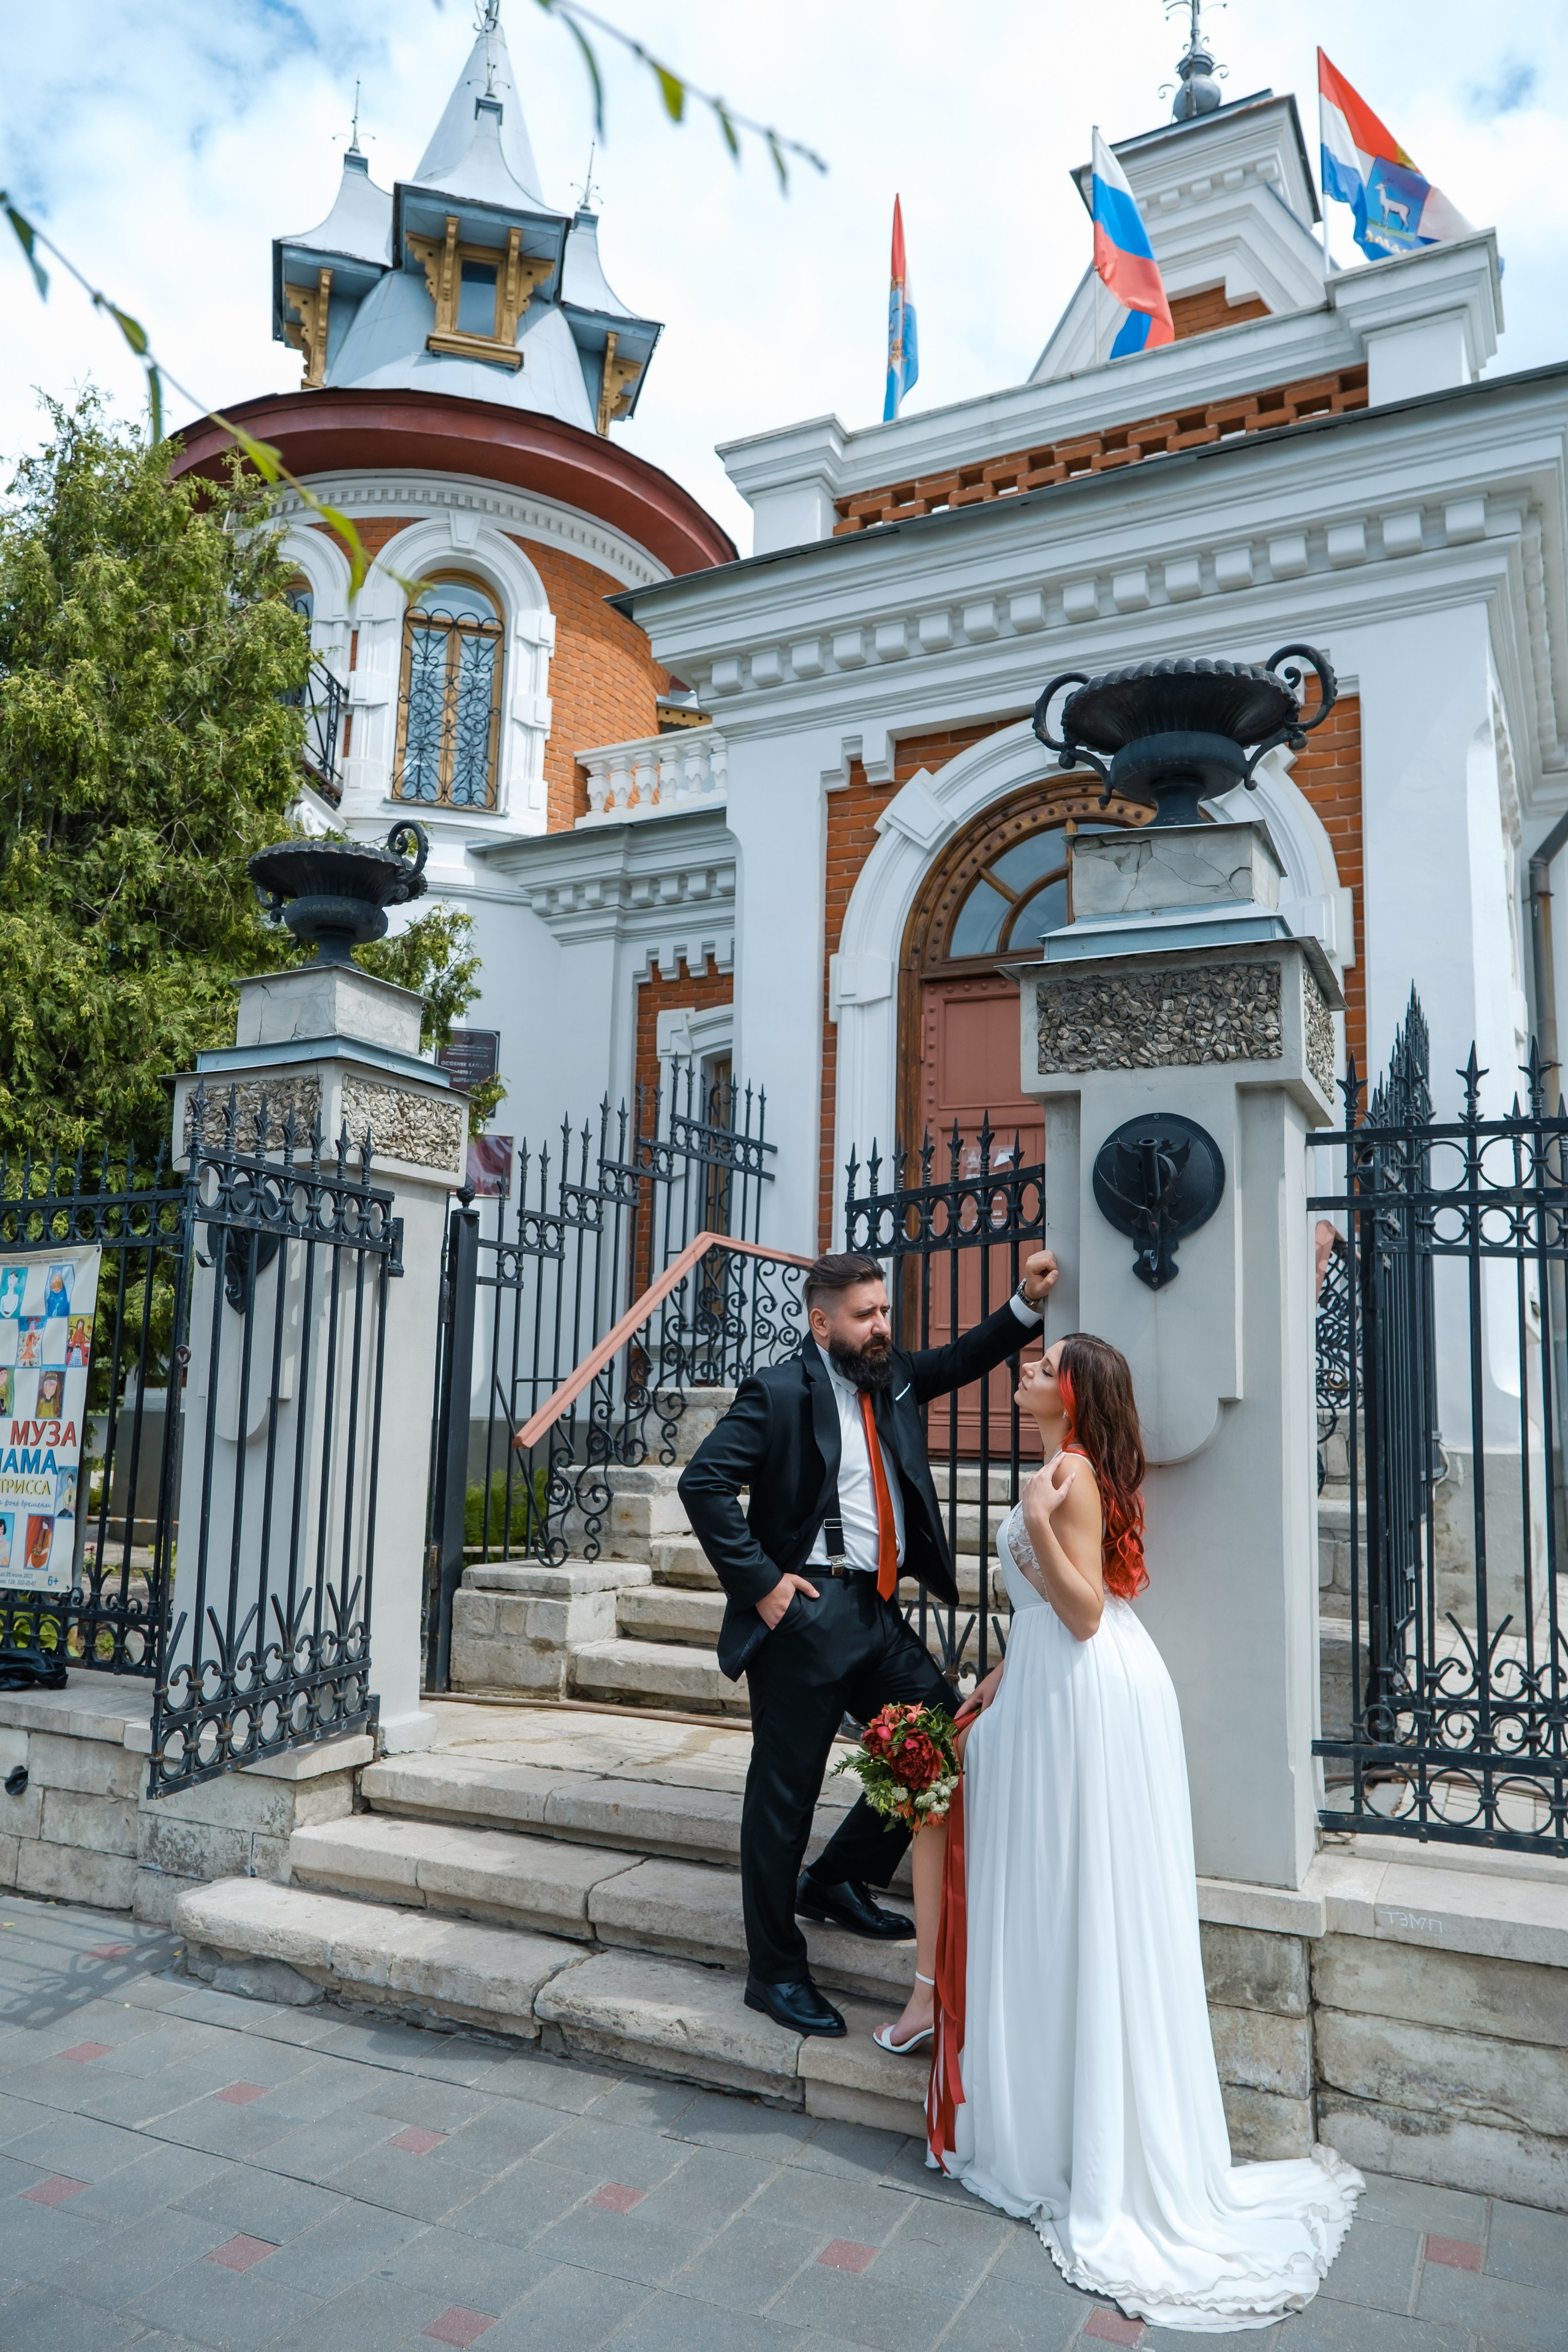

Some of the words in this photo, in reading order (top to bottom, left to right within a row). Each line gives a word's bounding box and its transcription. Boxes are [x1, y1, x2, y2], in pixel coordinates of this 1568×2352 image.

[10, 1420, 77, 1447] МУЗА
[21, 1499, 51, 1509] времени
[47, 1575, 59, 1586] 6+
